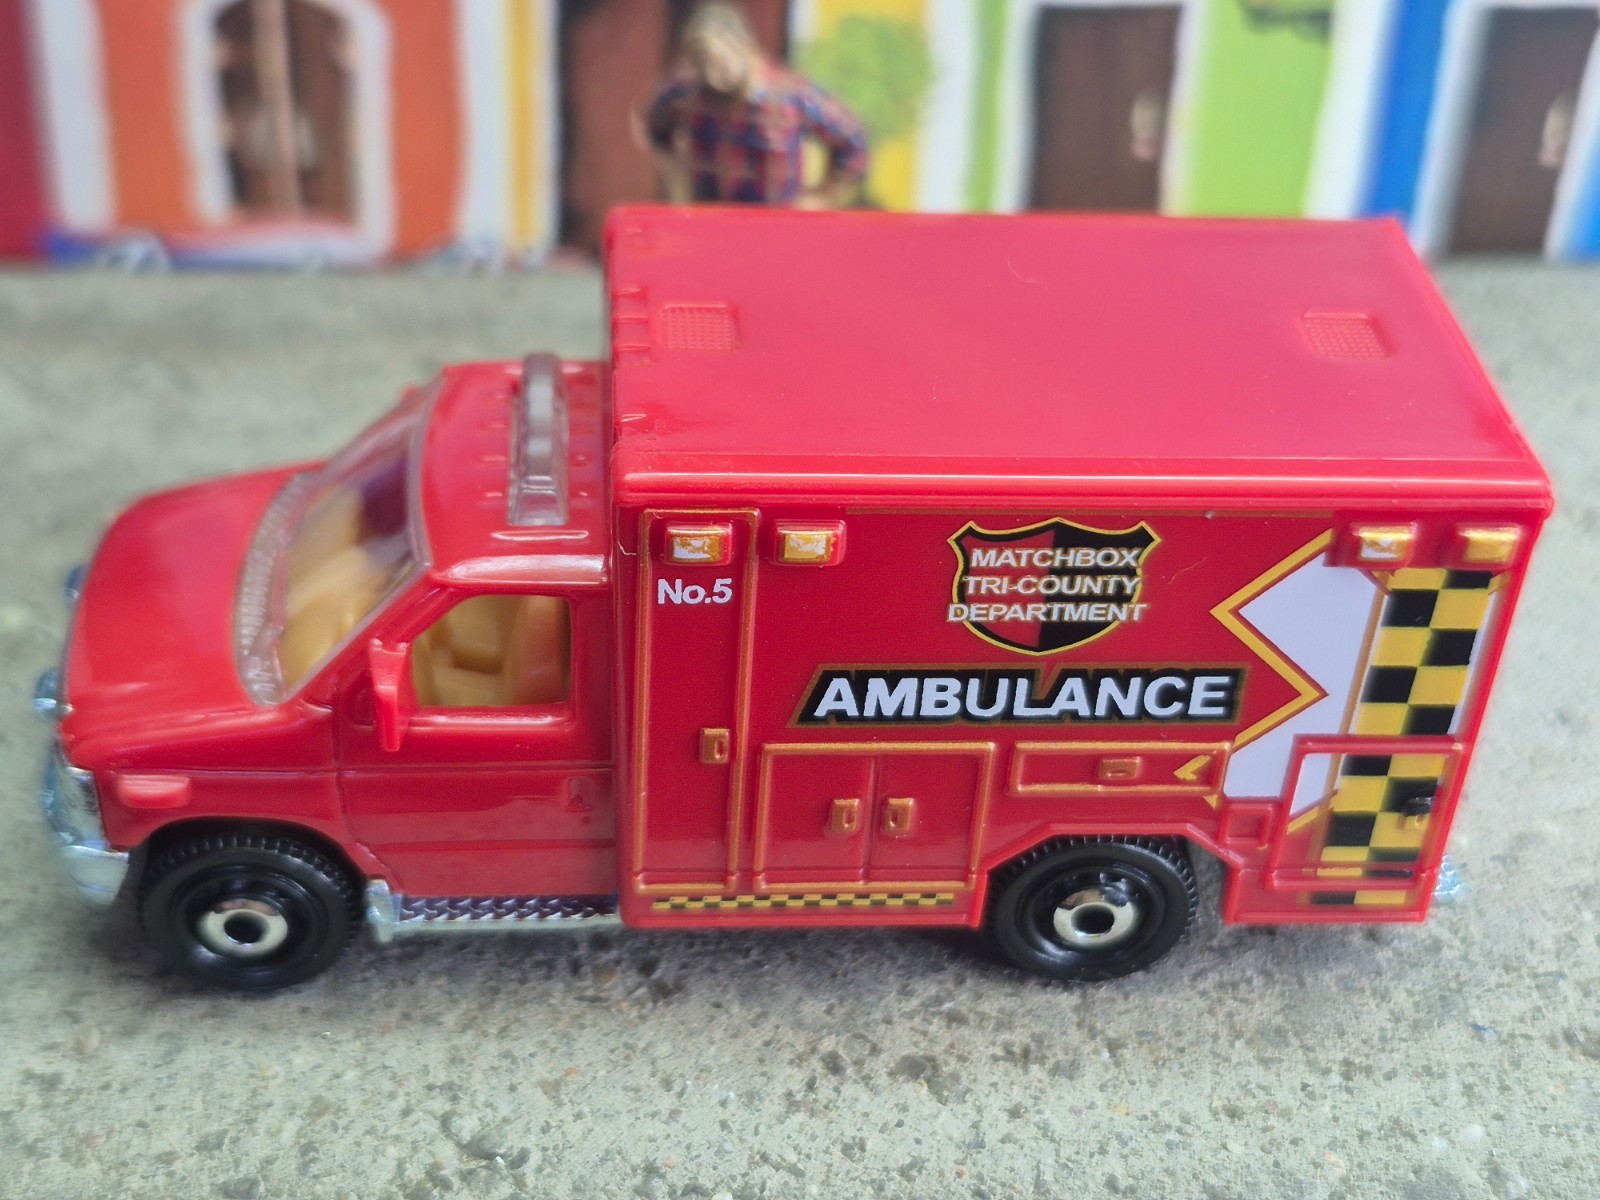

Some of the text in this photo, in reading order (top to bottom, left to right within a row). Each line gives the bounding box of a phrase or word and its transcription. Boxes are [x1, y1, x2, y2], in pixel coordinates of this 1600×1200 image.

[970, 548, 1140, 568] MATCHBOX
[657, 578, 733, 605] No.5
[964, 575, 1142, 595] TRI-COUNTY
[948, 603, 1148, 622] DEPARTMENT
[814, 675, 1231, 717] AMBULANCE
